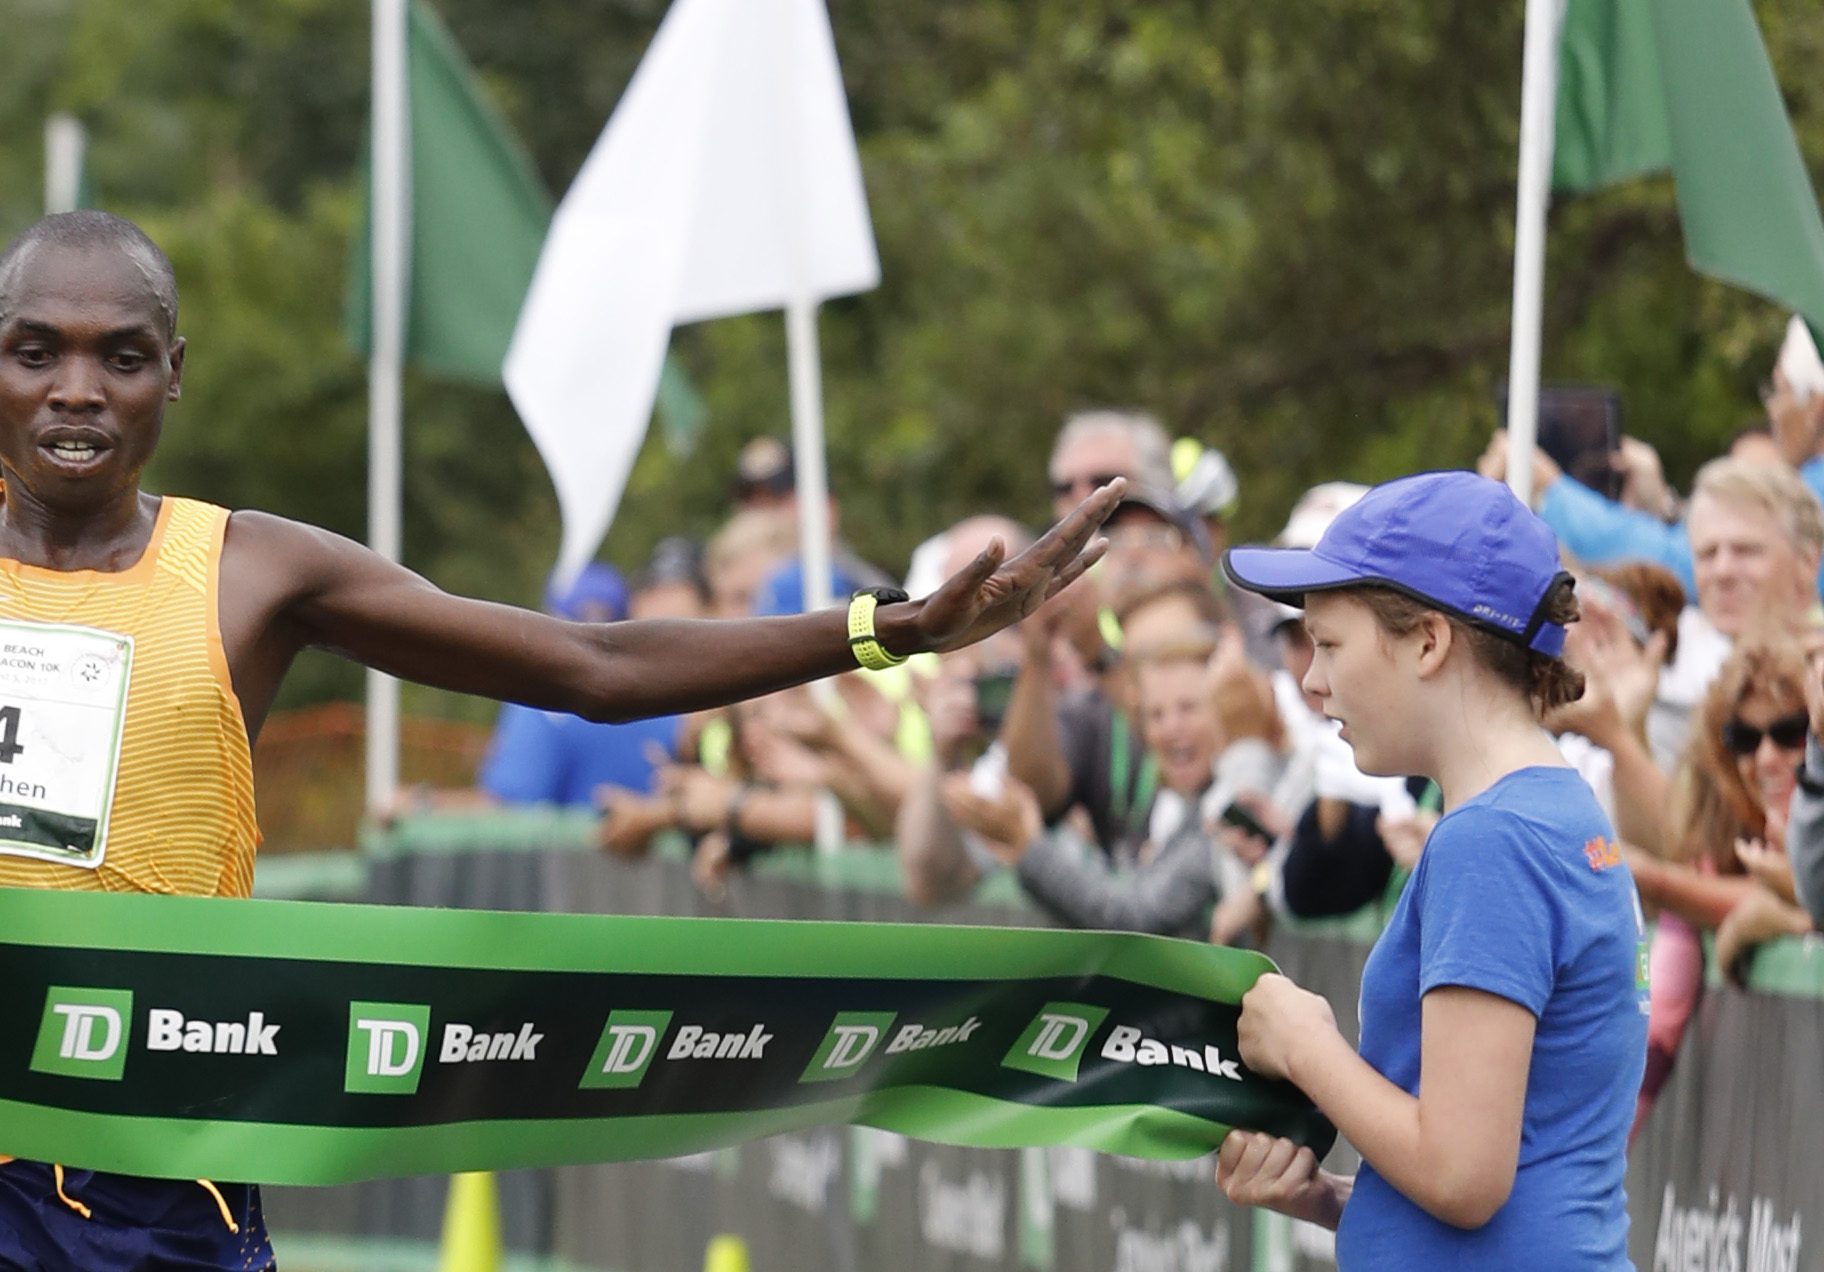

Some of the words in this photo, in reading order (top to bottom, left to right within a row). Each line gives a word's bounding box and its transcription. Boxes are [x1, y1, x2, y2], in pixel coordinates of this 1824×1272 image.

[4, 643, 45, 658] BEACH
[40, 661, 61, 673] 10K
[53, 1004, 123, 1061] TD
[147, 1008, 281, 1056] Bank
[357, 1019, 419, 1077] TD
[439, 1023, 544, 1064] Bank
[606, 1024, 657, 1073] TD
[667, 1023, 774, 1060] Bank
[823, 1023, 878, 1070] TD
[885, 1016, 982, 1055] Bank
[1026, 1013, 1086, 1060] TD
[1101, 1023, 1243, 1081] Bank
